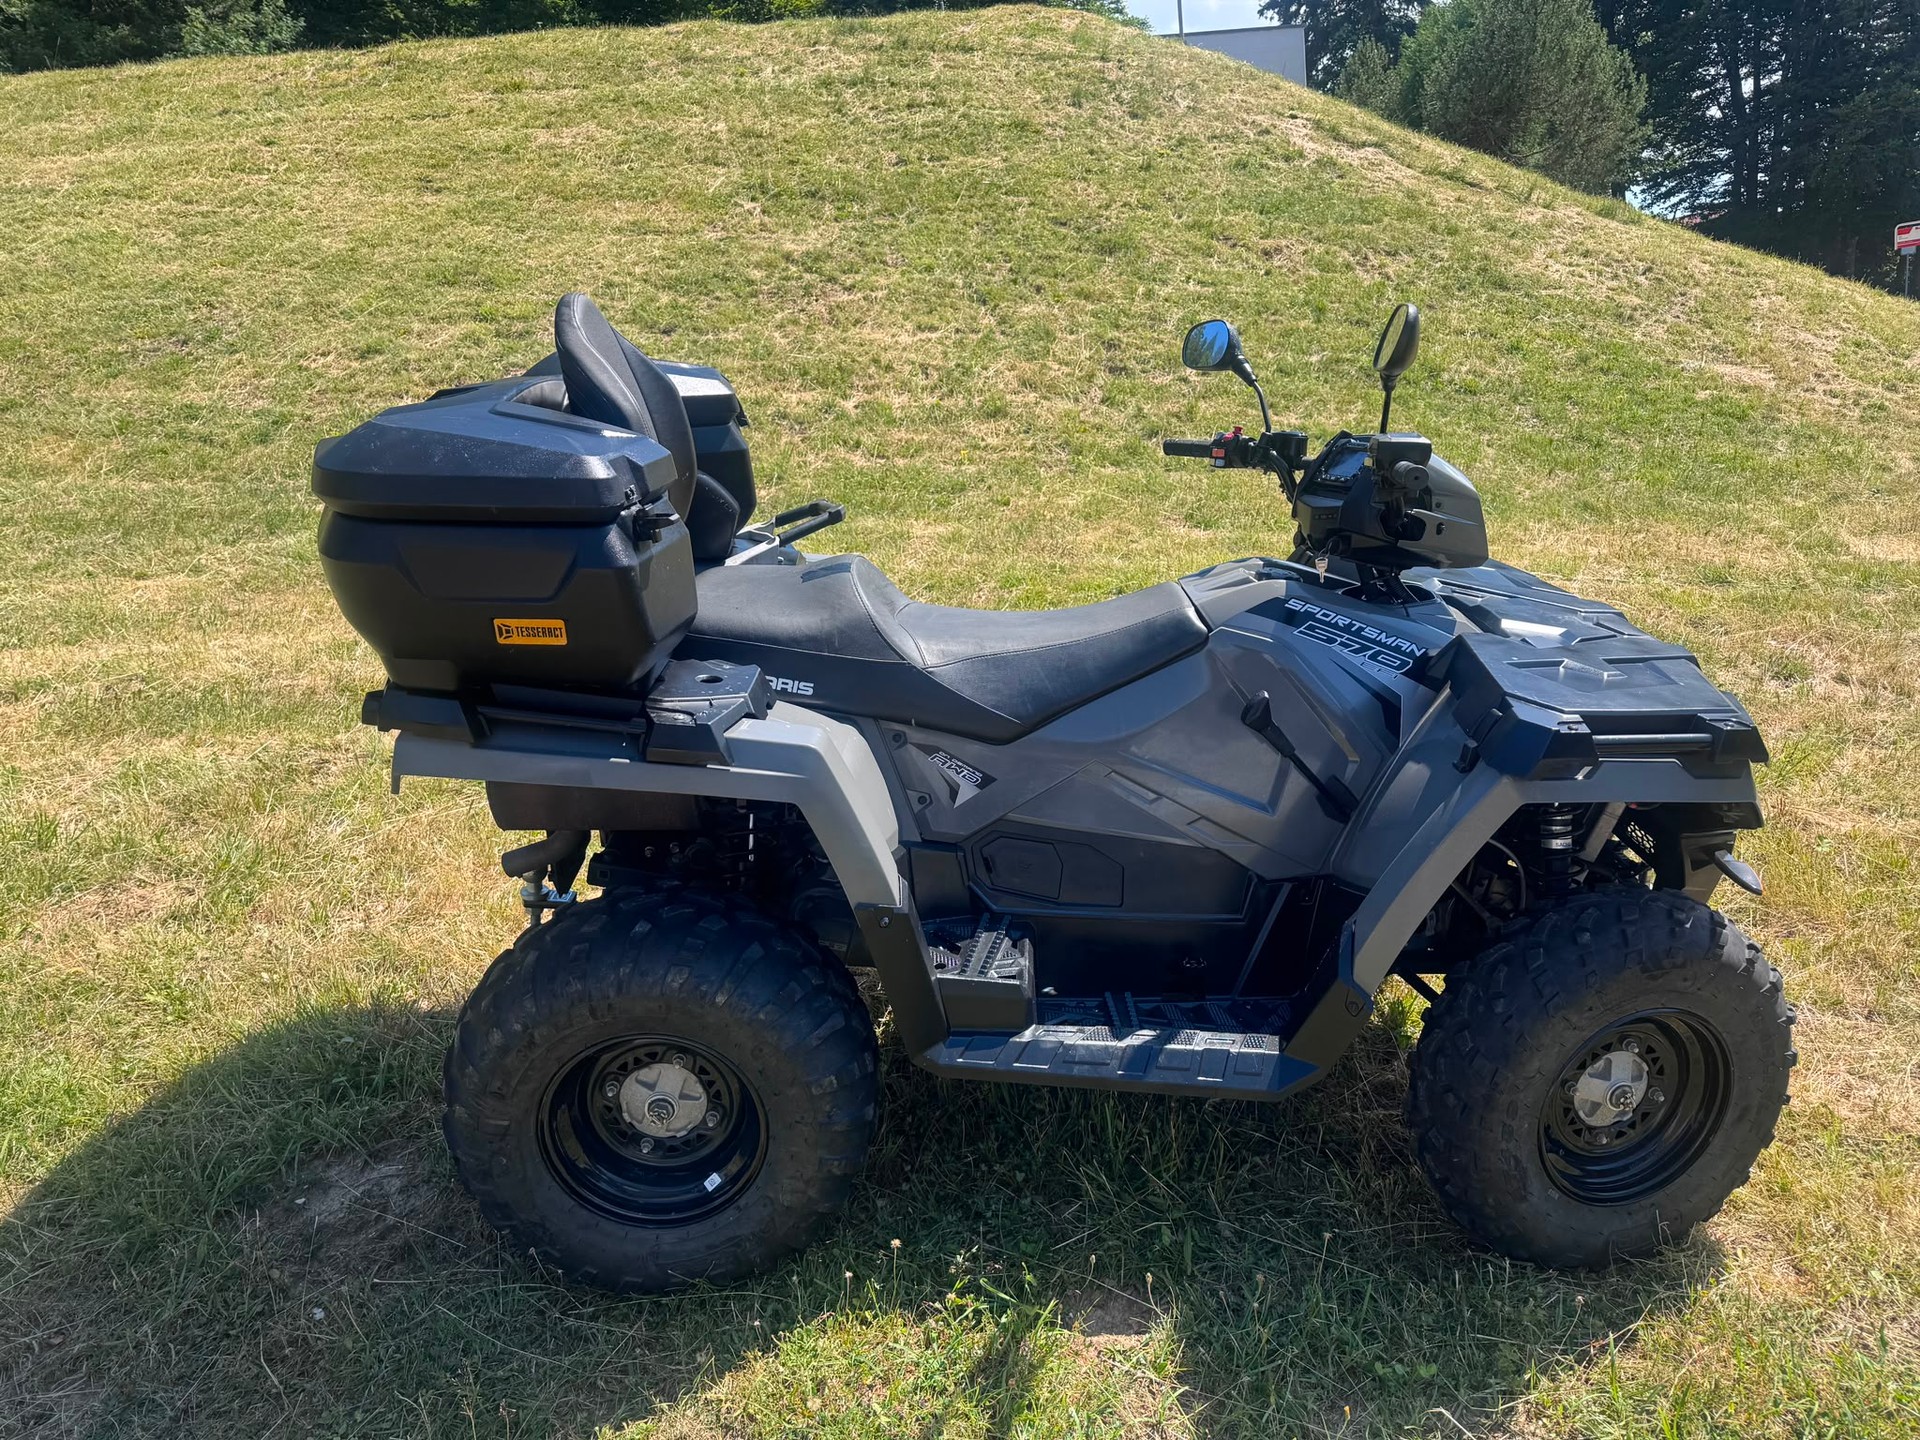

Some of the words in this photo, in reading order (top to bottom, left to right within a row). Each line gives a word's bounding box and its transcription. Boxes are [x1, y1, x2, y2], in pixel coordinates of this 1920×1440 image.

[515, 626, 563, 638] TESSERACT
[1285, 598, 1426, 657] SPORTSMAN
[1293, 621, 1413, 673] 570
[765, 675, 814, 696] ARIS
[928, 753, 981, 785] AWD
